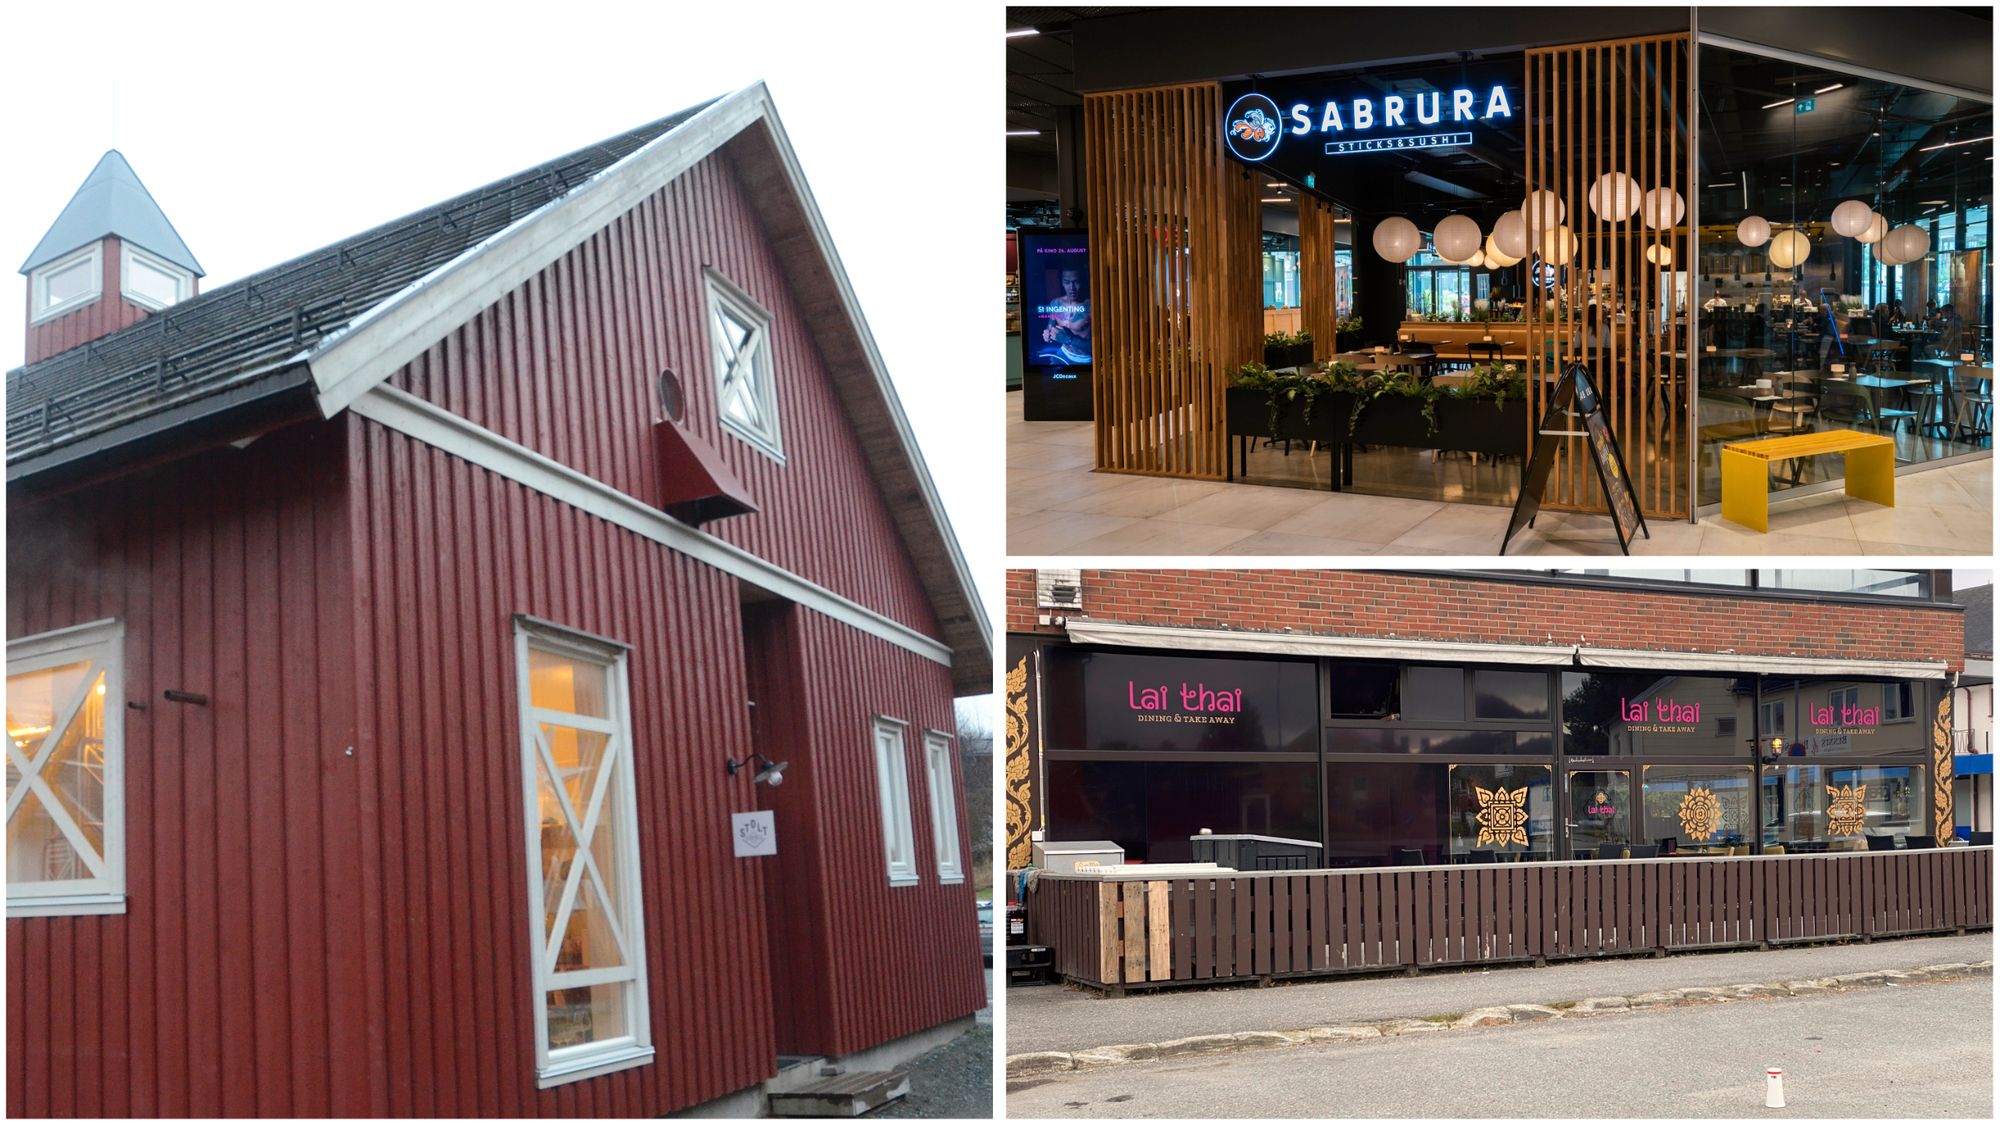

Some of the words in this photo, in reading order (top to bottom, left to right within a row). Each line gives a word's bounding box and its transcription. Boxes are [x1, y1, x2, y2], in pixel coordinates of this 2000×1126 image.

[1291, 85, 1512, 135] SABRURA
[1338, 135, 1458, 152] STICKS&SUSHI
[1174, 714, 1182, 722] &
[740, 819, 768, 838] STOLT
